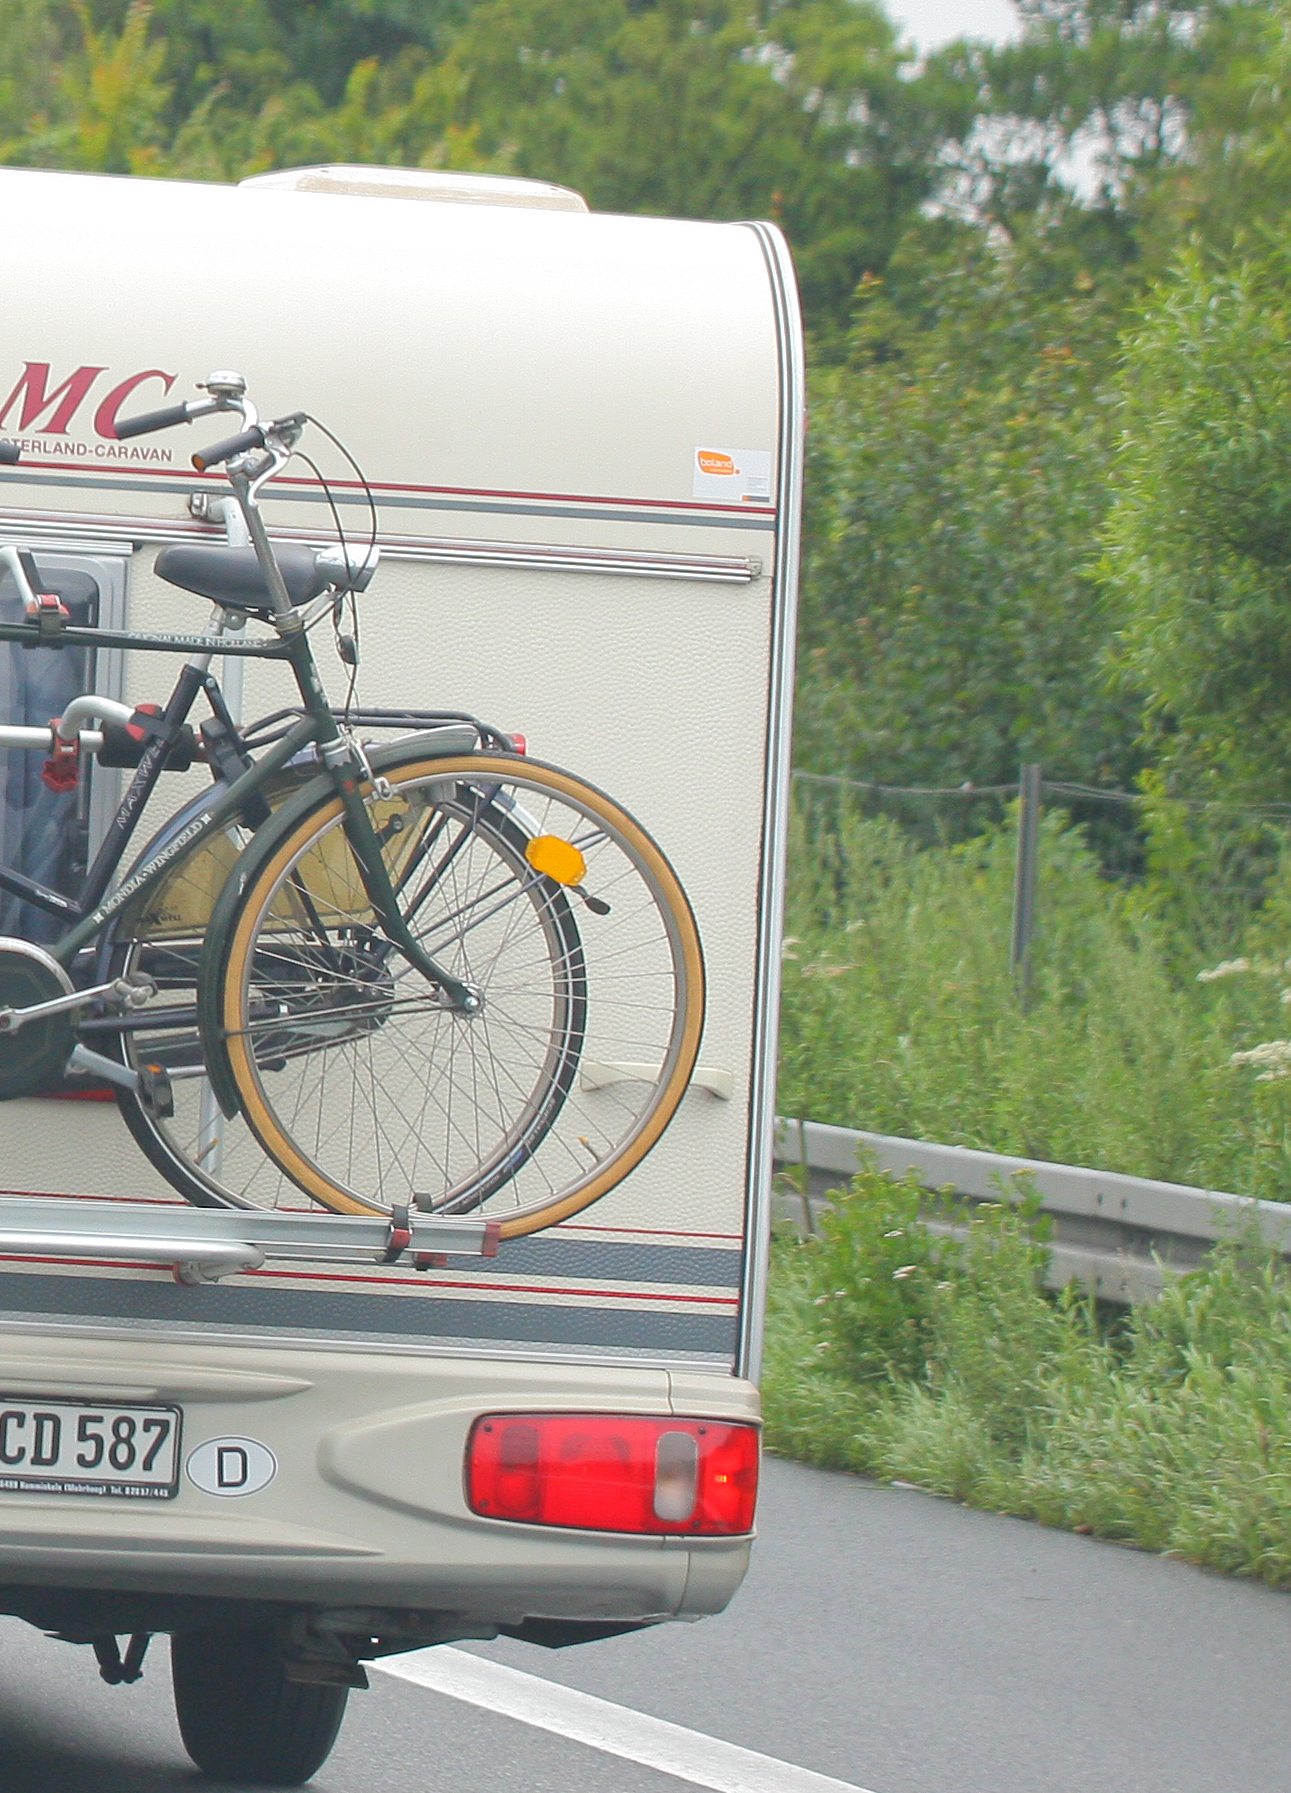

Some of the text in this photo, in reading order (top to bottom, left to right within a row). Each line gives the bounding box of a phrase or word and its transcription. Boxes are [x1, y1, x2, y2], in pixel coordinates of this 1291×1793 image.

[0, 436, 173, 463] TERLAND-CARAVAN
[116, 737, 166, 830] MAXWEL
[76, 1414, 171, 1472] 587
[217, 1446, 249, 1488] D
